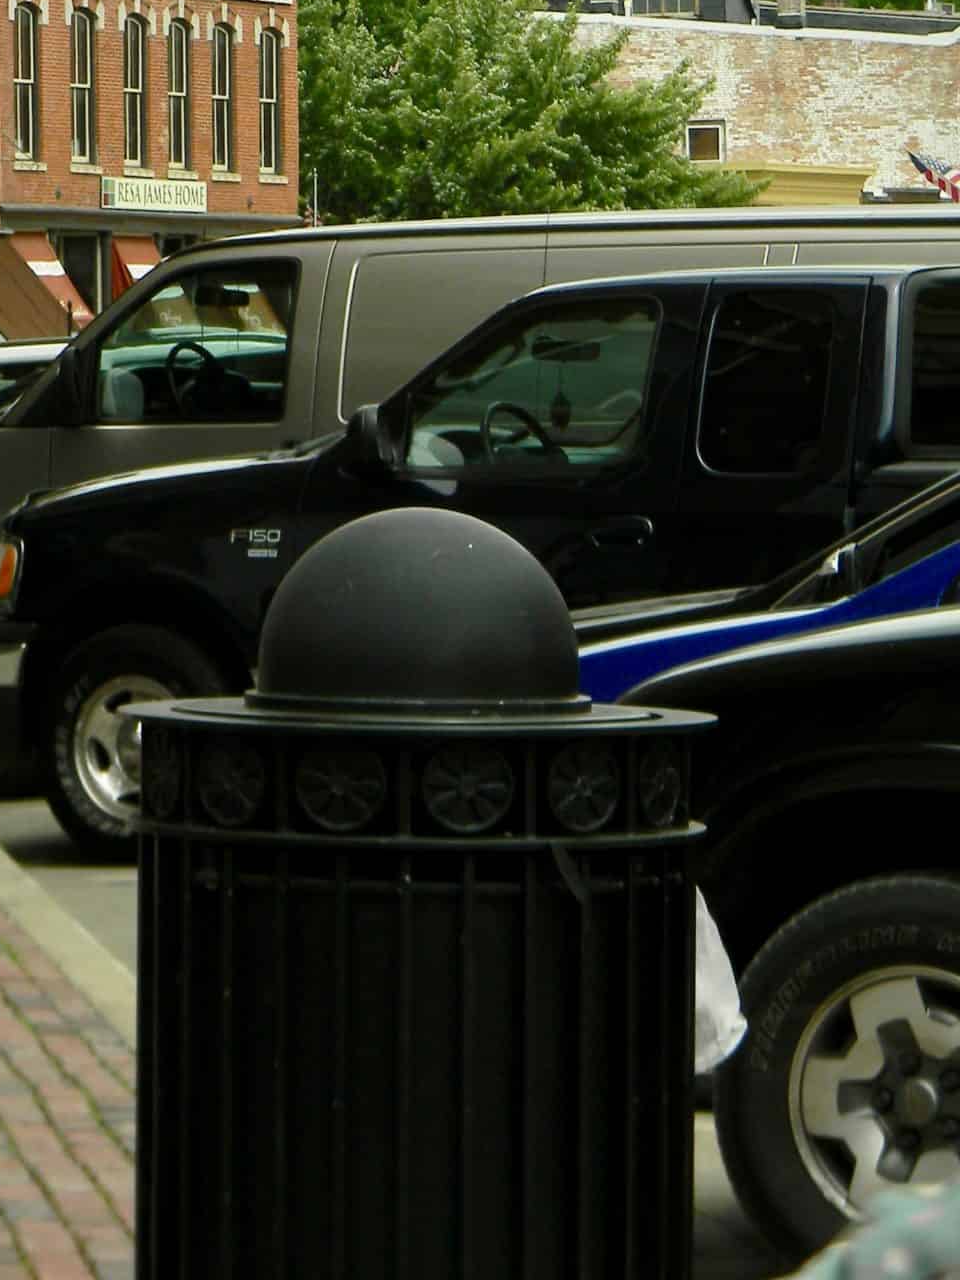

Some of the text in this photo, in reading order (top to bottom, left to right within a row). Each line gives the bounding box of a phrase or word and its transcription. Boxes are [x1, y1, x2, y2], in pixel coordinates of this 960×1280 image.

[118, 182, 205, 207] RESA JAMES HOME
